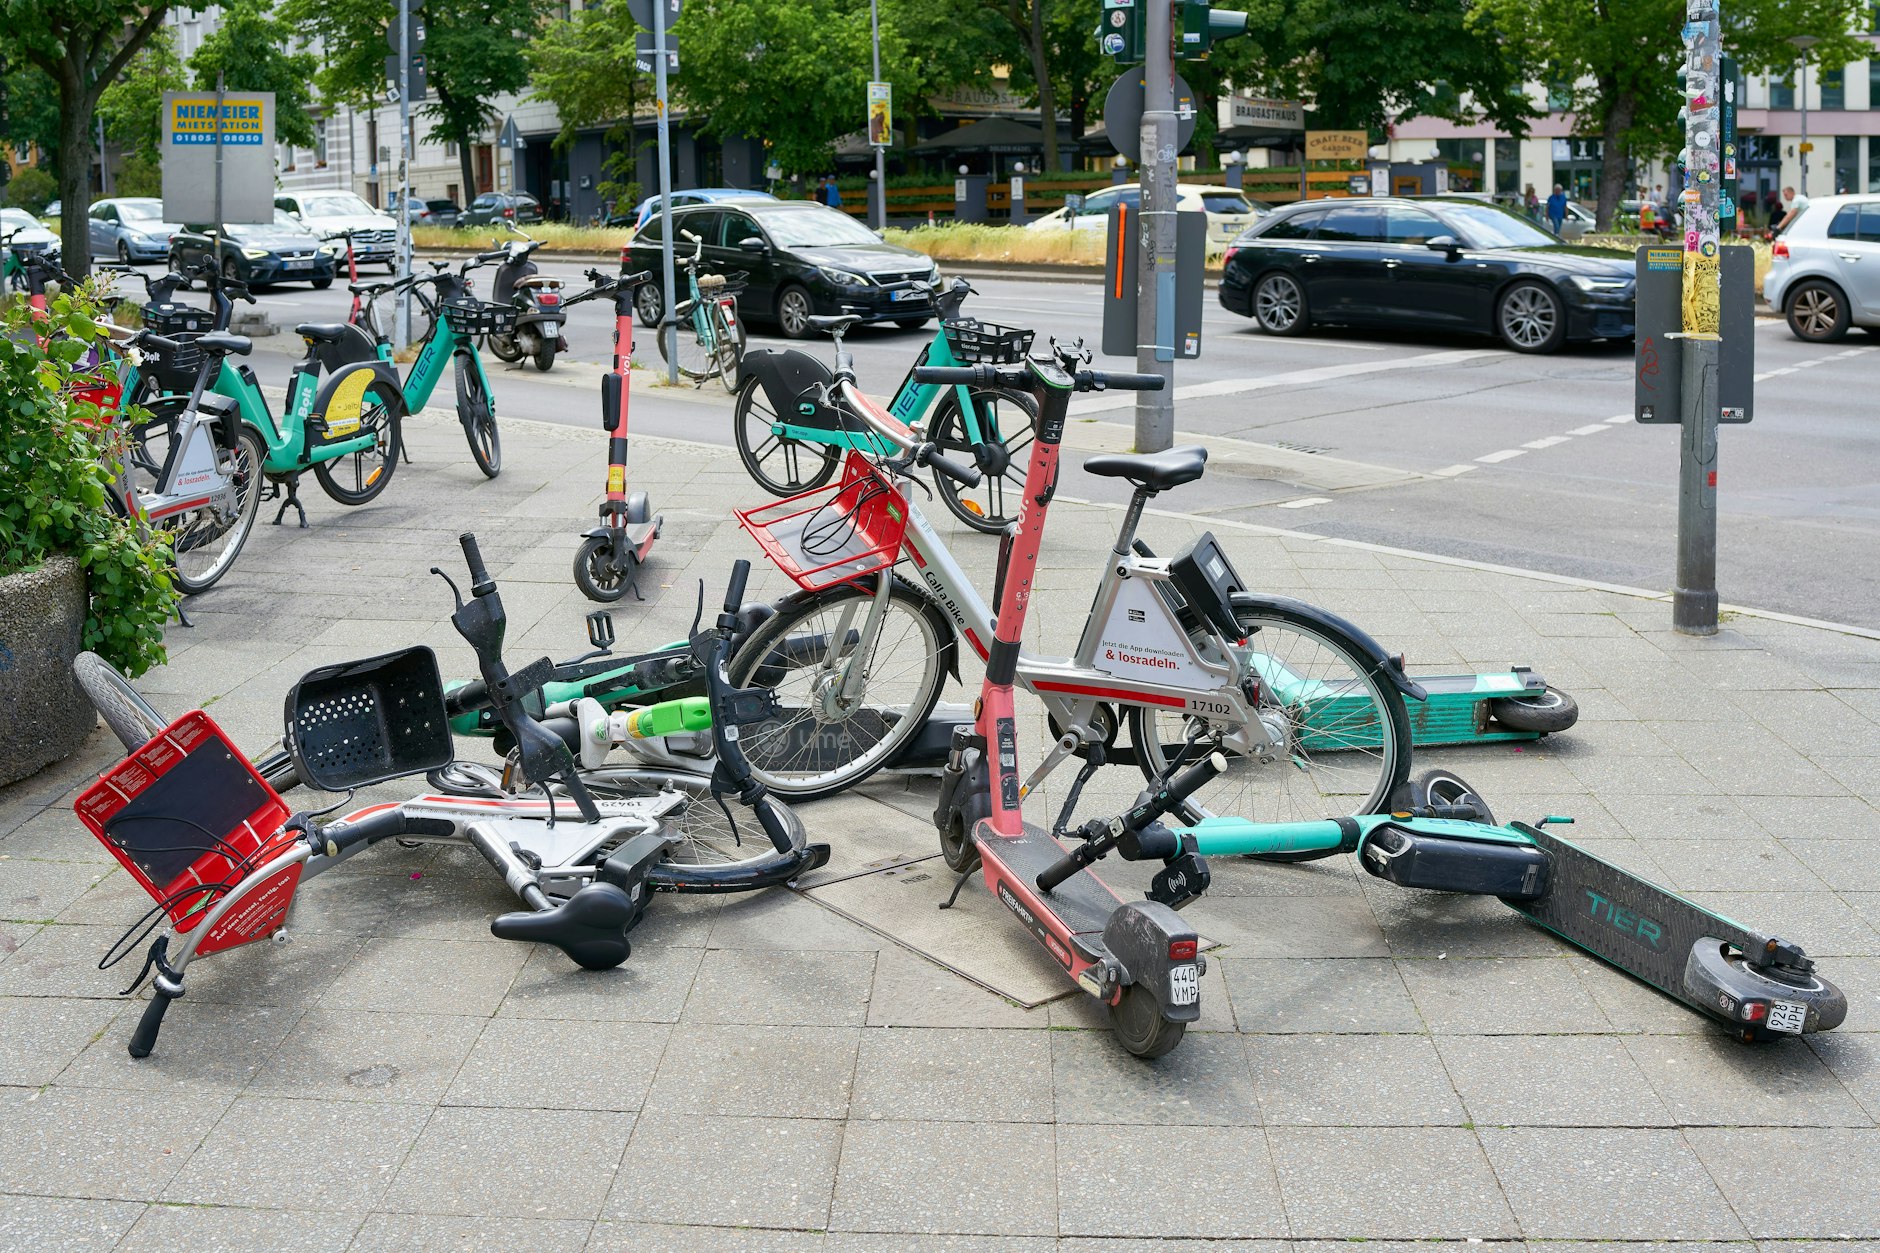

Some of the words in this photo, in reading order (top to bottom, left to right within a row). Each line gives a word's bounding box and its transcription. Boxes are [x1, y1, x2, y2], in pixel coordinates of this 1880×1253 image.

[176, 105, 260, 119] NIEMEIER
[1236, 105, 1297, 121] BRAUGASTHAUS
[176, 121, 260, 130] MIETSATION
[1310, 135, 1339, 148] CRAFT
[1342, 135, 1364, 147] BEER
[961, 343, 981, 351] tier.app
[408, 346, 437, 392] TIER
[621, 352, 632, 376] voi.
[126, 370, 140, 395] TIE
[298, 387, 313, 419] Bolt
[893, 382, 922, 417] IER
[177, 478, 183, 486] &
[184, 473, 211, 485] losradeln.
[211, 493, 227, 503] 12936
[1015, 499, 1030, 535] voi.
[925, 571, 945, 593] Call
[939, 592, 949, 601] a
[945, 599, 966, 625] Bike
[1102, 640, 1118, 649] Jetzt
[1118, 641, 1129, 650] die
[1129, 644, 1143, 653] App
[1144, 646, 1185, 658] downloaden
[1105, 649, 1115, 660] &
[1118, 651, 1181, 670] losradeln.
[1191, 700, 1231, 715] 17102
[216, 929, 228, 941] Auf
[227, 918, 240, 930] den
[238, 901, 260, 920] Sattel,
[258, 886, 280, 903] fertig,
[277, 875, 291, 887] los!
[1586, 890, 1661, 949] TIER
[1173, 968, 1196, 984] 440
[1173, 986, 1197, 1002] YMP
[1771, 1003, 1788, 1027] 928
[1786, 1005, 1804, 1030] WPH
